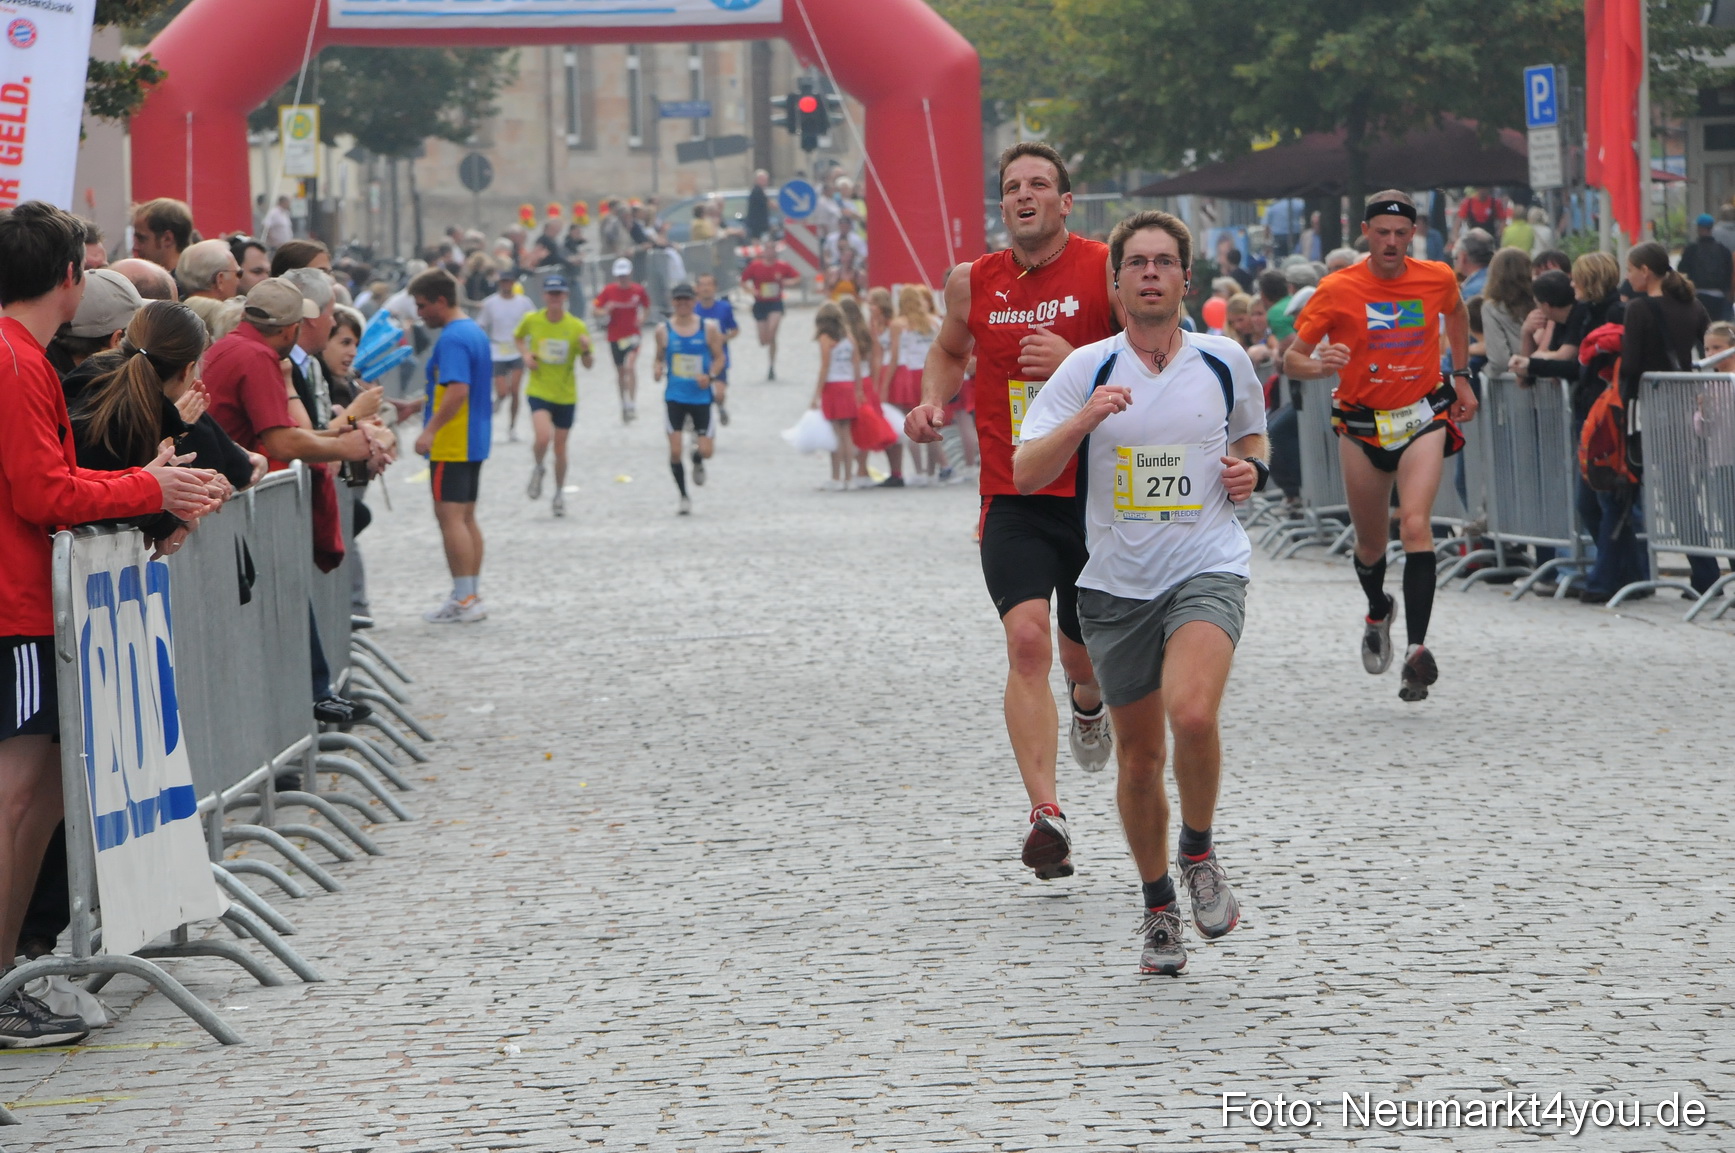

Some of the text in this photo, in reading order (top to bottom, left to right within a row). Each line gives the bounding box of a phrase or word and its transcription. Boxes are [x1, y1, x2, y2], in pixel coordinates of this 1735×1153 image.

[1531, 74, 1550, 120] P
[0, 76, 32, 166] GELD.
[988, 299, 1060, 324] suisse 08
[1391, 408, 1412, 419] Frank
[1137, 452, 1181, 468] Gunder
[1117, 474, 1123, 486] B
[1146, 475, 1192, 498] 270
